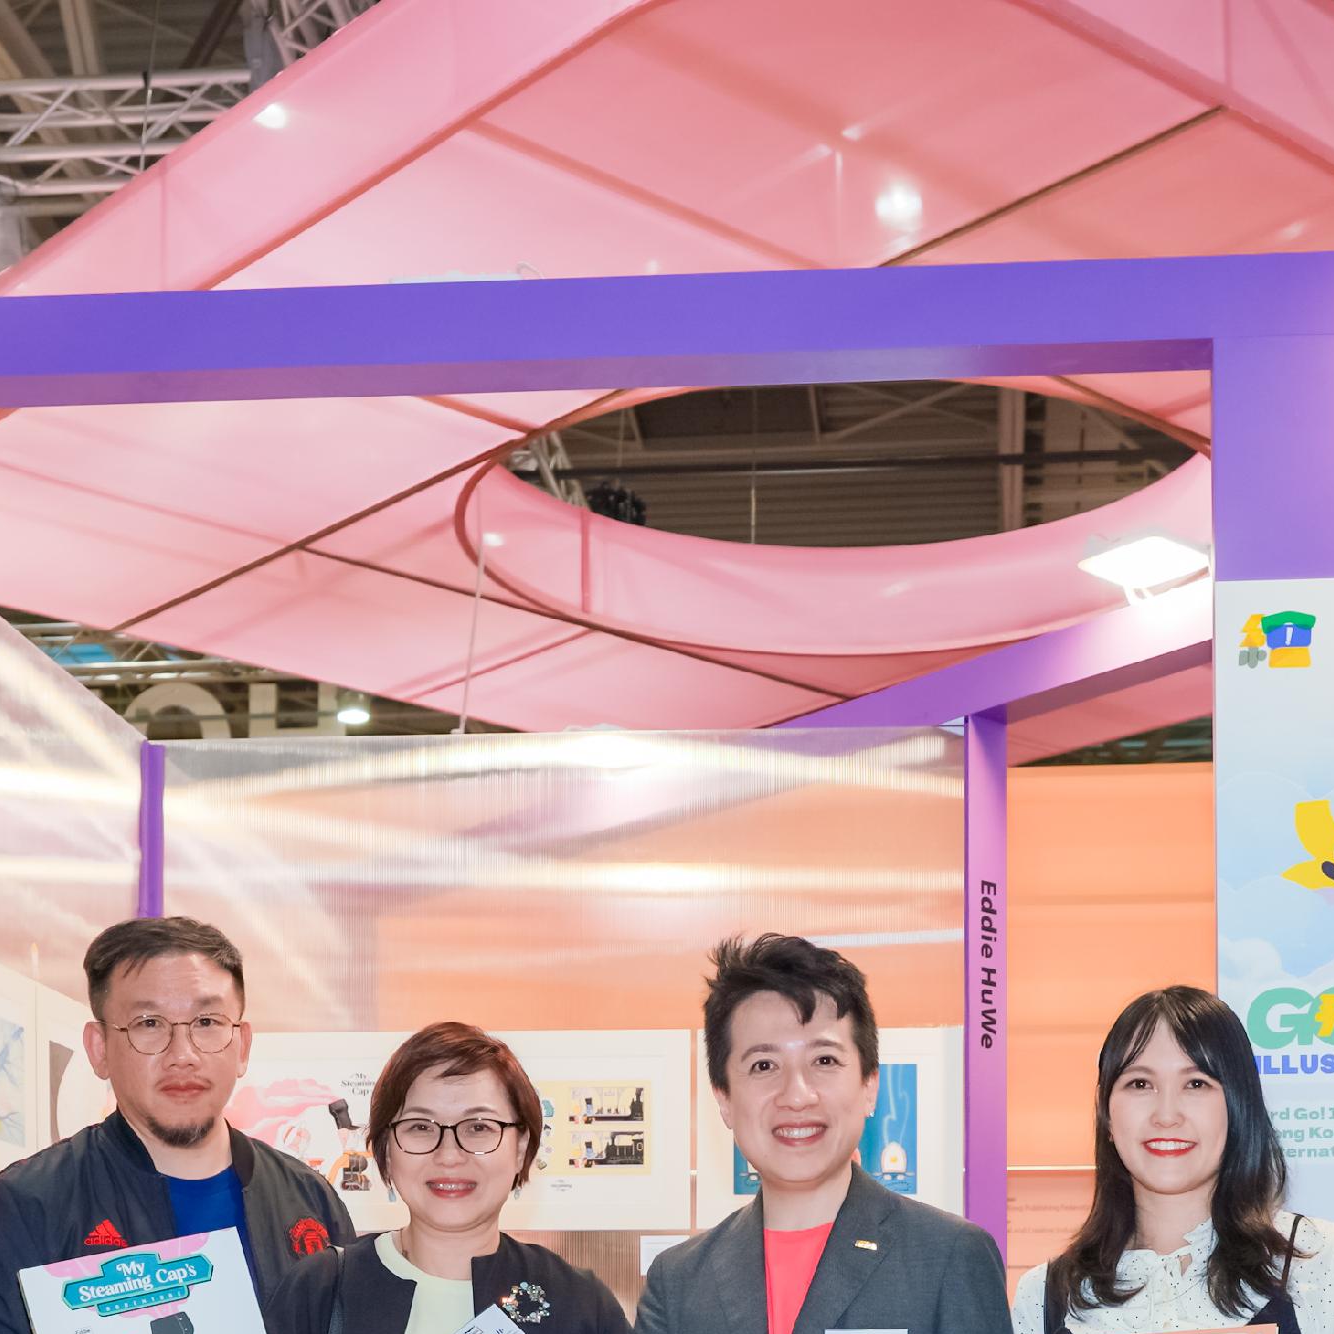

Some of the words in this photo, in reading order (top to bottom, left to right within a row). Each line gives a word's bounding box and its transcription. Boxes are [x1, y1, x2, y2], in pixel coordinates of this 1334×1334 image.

[981, 879, 997, 959] Eddie
[981, 967, 997, 1050] HuWe
[84, 1234, 128, 1249] adidas
[78, 1276, 153, 1303] Steaming
[155, 1264, 197, 1285] Cap's
[116, 1261, 145, 1276] My
